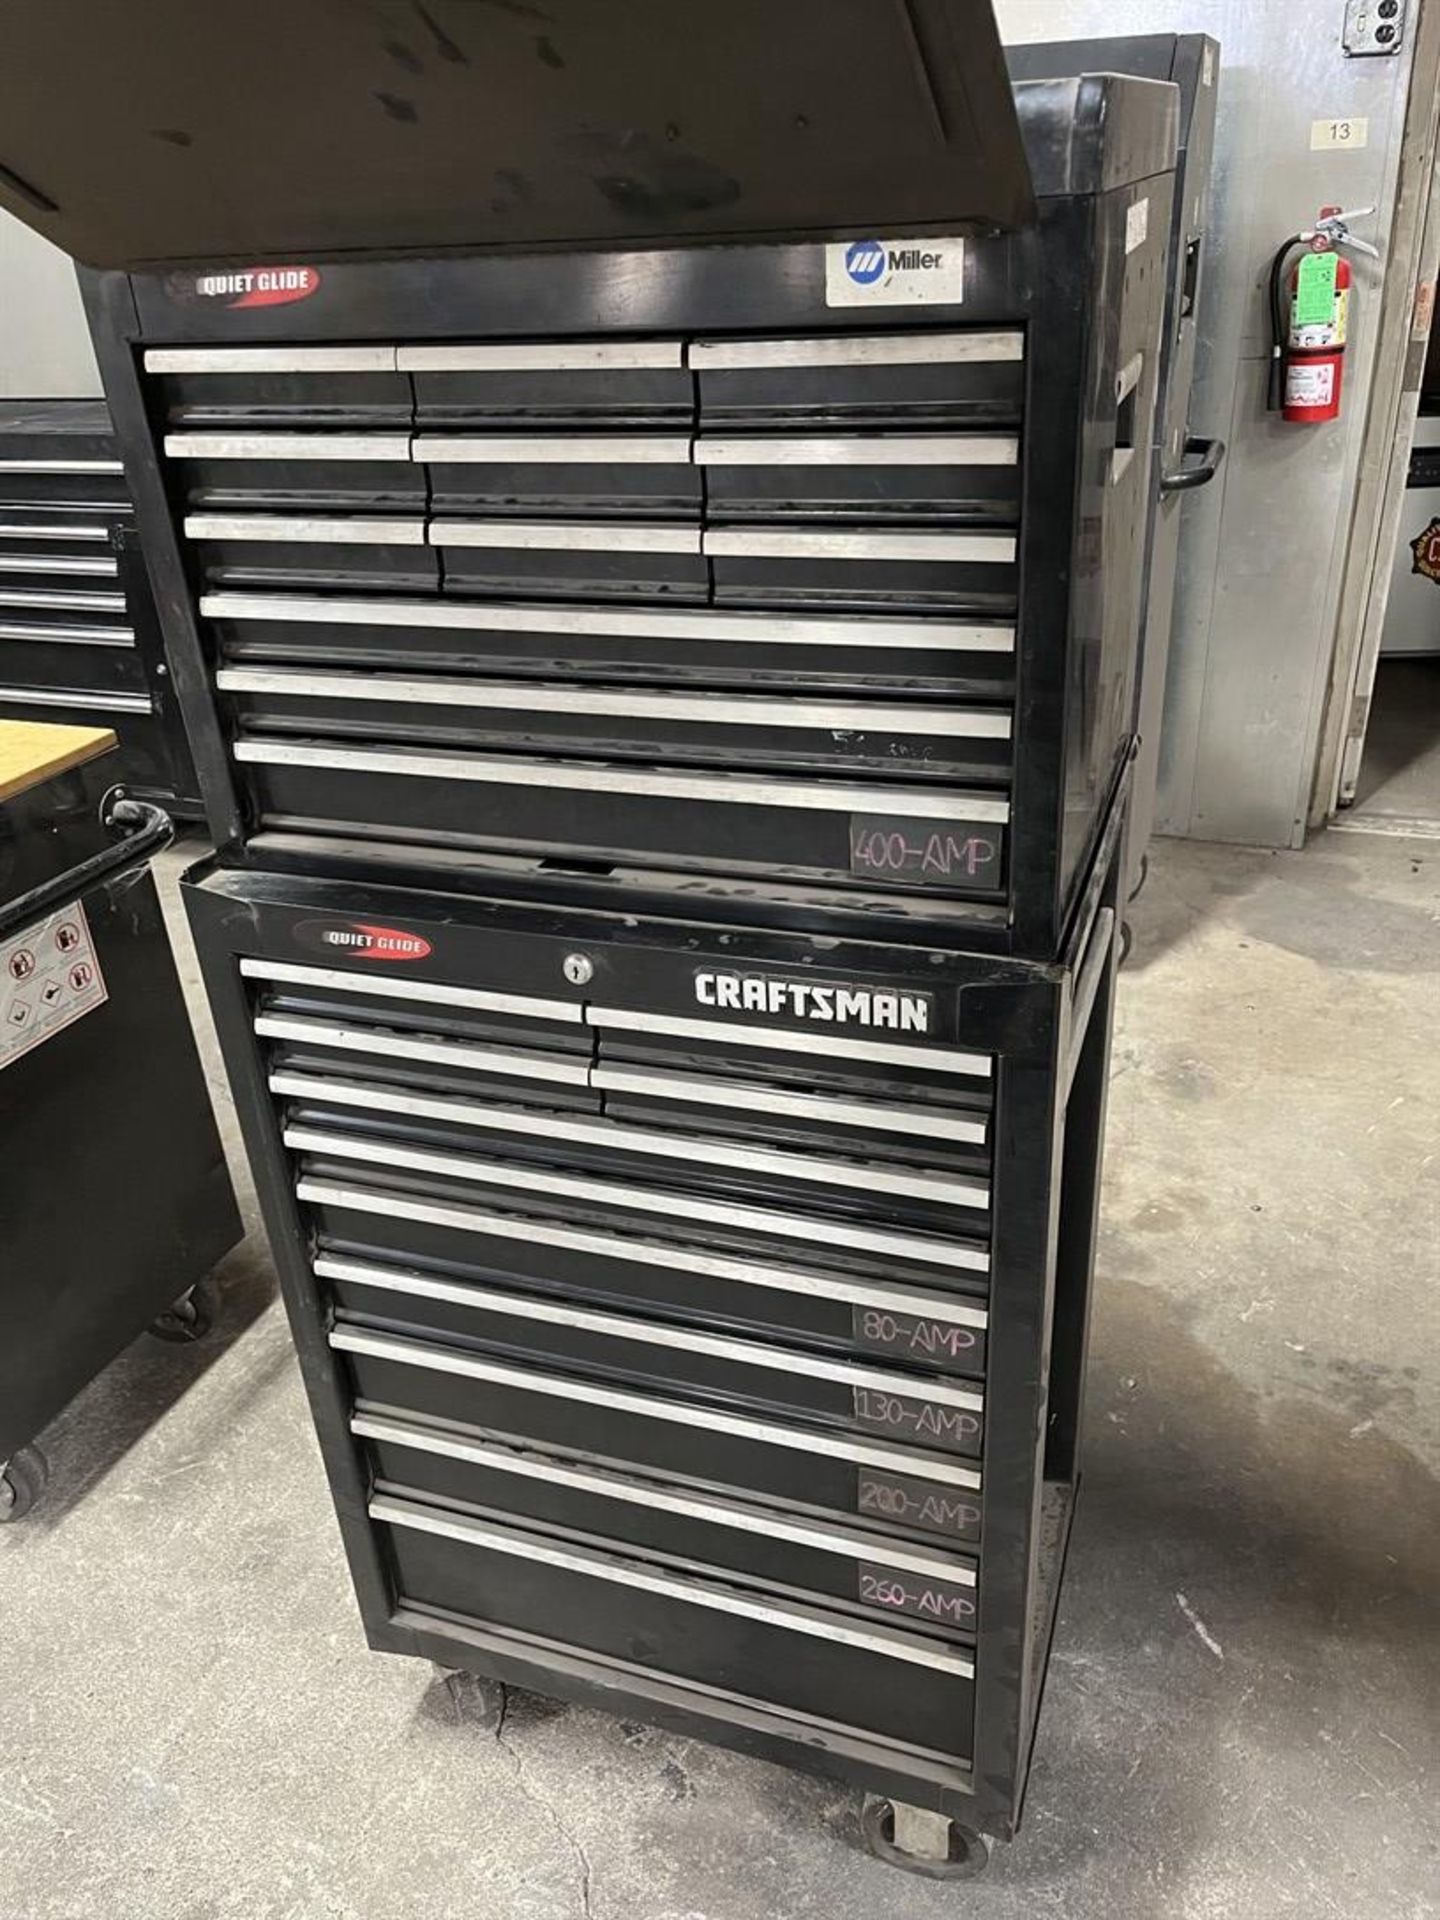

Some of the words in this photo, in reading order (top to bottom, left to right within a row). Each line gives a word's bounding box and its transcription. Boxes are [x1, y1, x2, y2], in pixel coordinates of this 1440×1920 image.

[1329, 122, 1351, 140] 13
[888, 249, 943, 271] Miller
[203, 274, 254, 296] QUIET
[257, 271, 309, 291] GLIDE
[854, 829, 996, 875] 400-AMP
[328, 931, 374, 947] QUIET
[377, 937, 422, 953] GLIDE
[694, 973, 928, 1032] CRAFTSMAN
[863, 1311, 976, 1357] 80-AMP
[857, 1390, 979, 1441] 130-AMP
[861, 1481, 981, 1530] 200-AMP
[861, 1575, 976, 1621] 260-AMP
